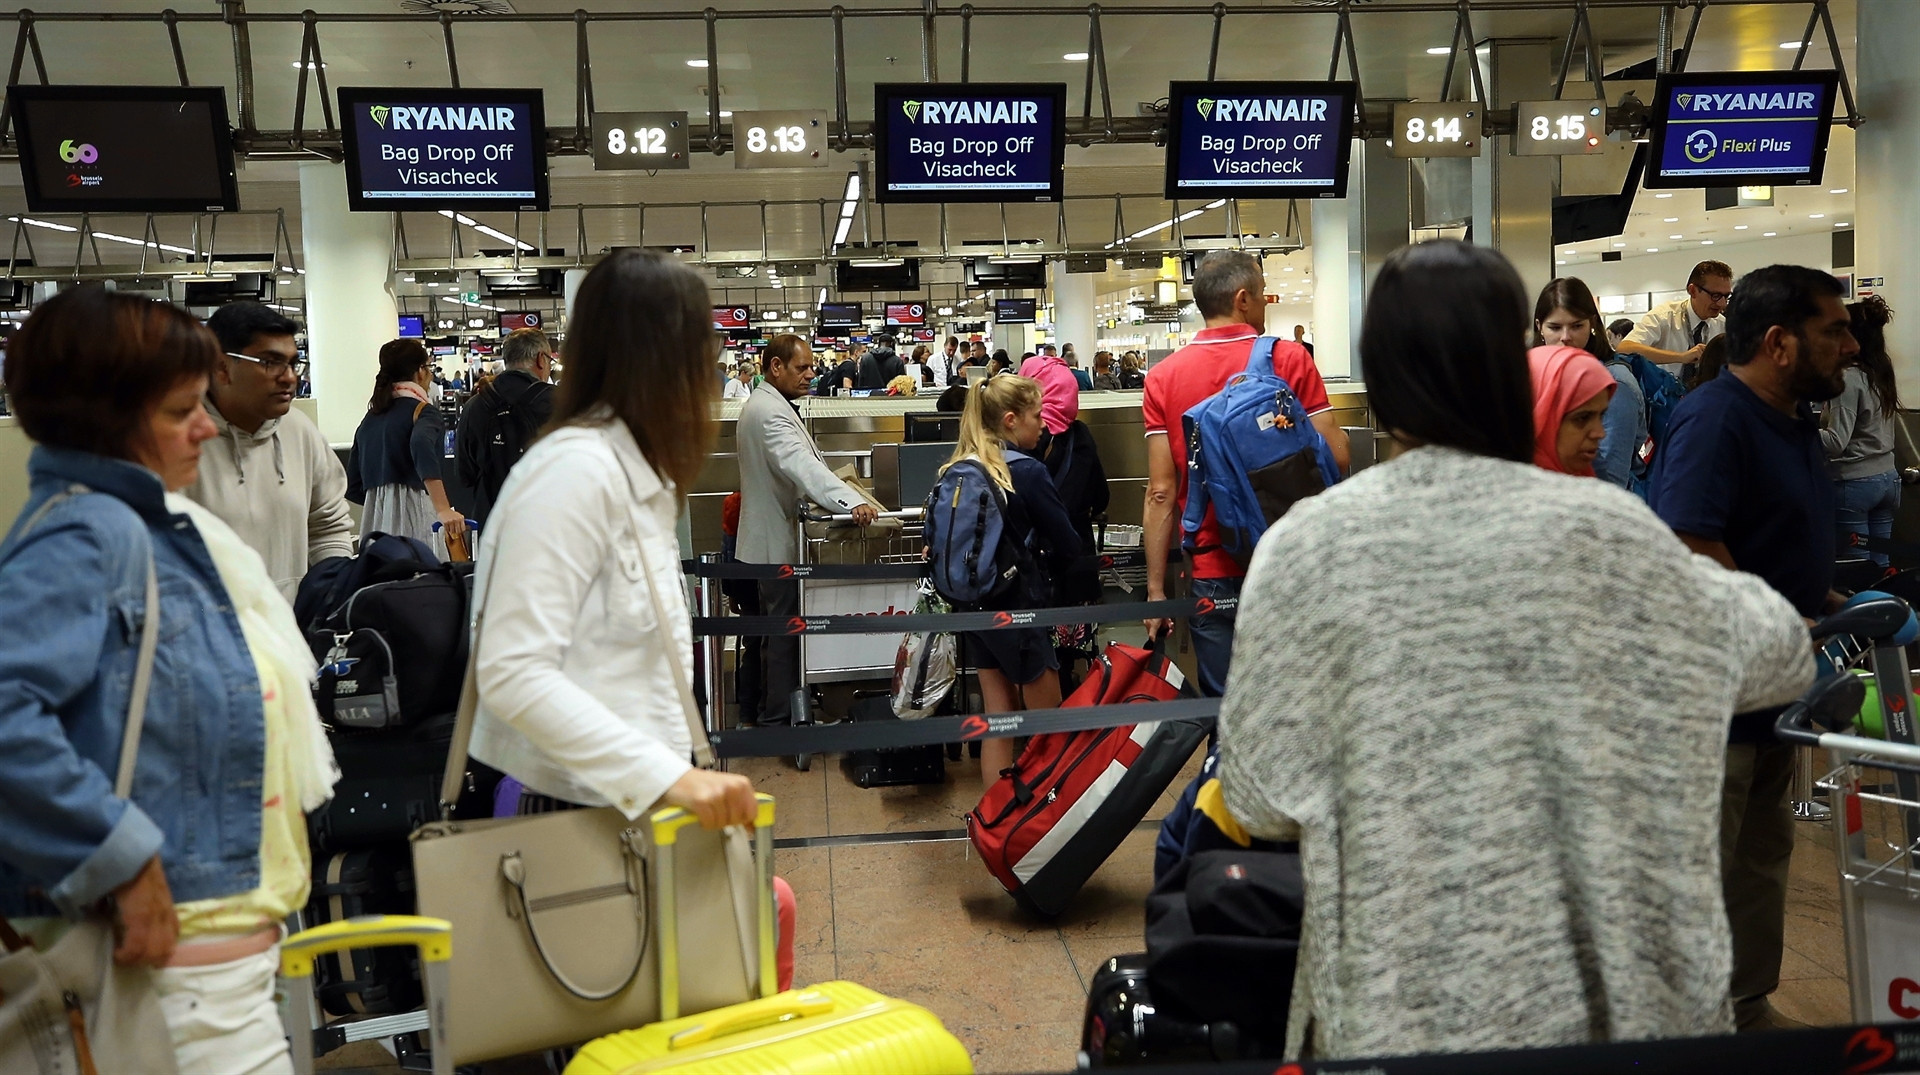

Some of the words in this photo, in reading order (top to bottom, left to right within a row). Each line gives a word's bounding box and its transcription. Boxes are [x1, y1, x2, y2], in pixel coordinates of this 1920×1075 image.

[923, 101, 1038, 124] RYANAIR
[1215, 99, 1327, 122] RYANAIR
[1693, 92, 1815, 111] RYANAIR
[392, 106, 515, 131] RYANAIR
[1530, 115, 1585, 141] 8.15
[608, 127, 667, 154] 8.12
[746, 126, 806, 153] 8.13
[1406, 117, 1461, 143] 8.14
[60, 140, 98, 164] 60
[382, 144, 419, 164] Bag
[428, 144, 476, 164] Drop
[483, 144, 514, 161] Off
[910, 138, 945, 157] Bag
[953, 138, 998, 156] Drop
[1005, 136, 1034, 153] Off
[1201, 135, 1235, 154] Bag
[1243, 135, 1286, 153] Drop
[1293, 134, 1322, 150] Off
[1722, 139, 1756, 153] Flexi
[1760, 138, 1791, 152] Plus
[398, 168, 498, 185] Visacheck
[923, 160, 1017, 177] Visacheck
[1213, 158, 1303, 174] Visacheck
